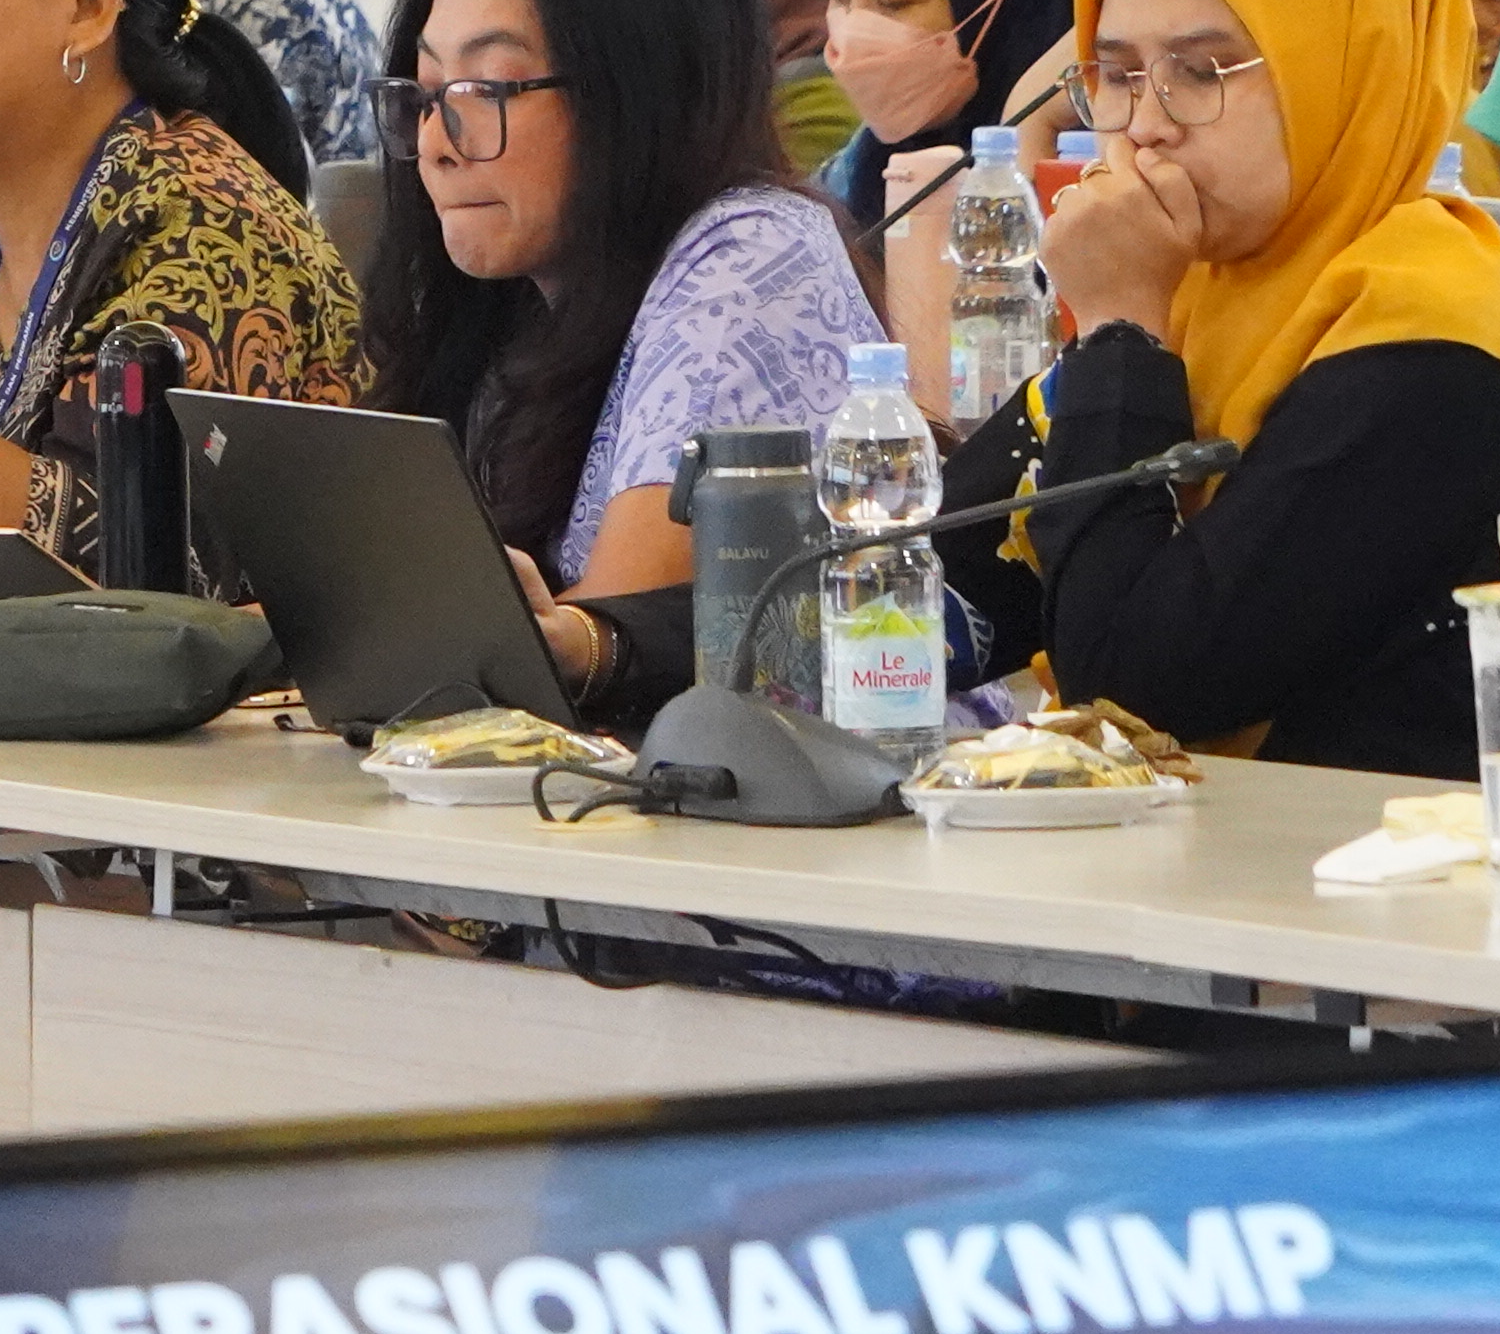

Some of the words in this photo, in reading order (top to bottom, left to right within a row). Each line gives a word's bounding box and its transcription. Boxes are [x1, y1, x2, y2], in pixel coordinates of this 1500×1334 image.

[4, 373, 17, 397] DAN
[14, 311, 35, 371] PERIKANAN
[881, 651, 905, 671] Le
[852, 667, 932, 688] Minerale
